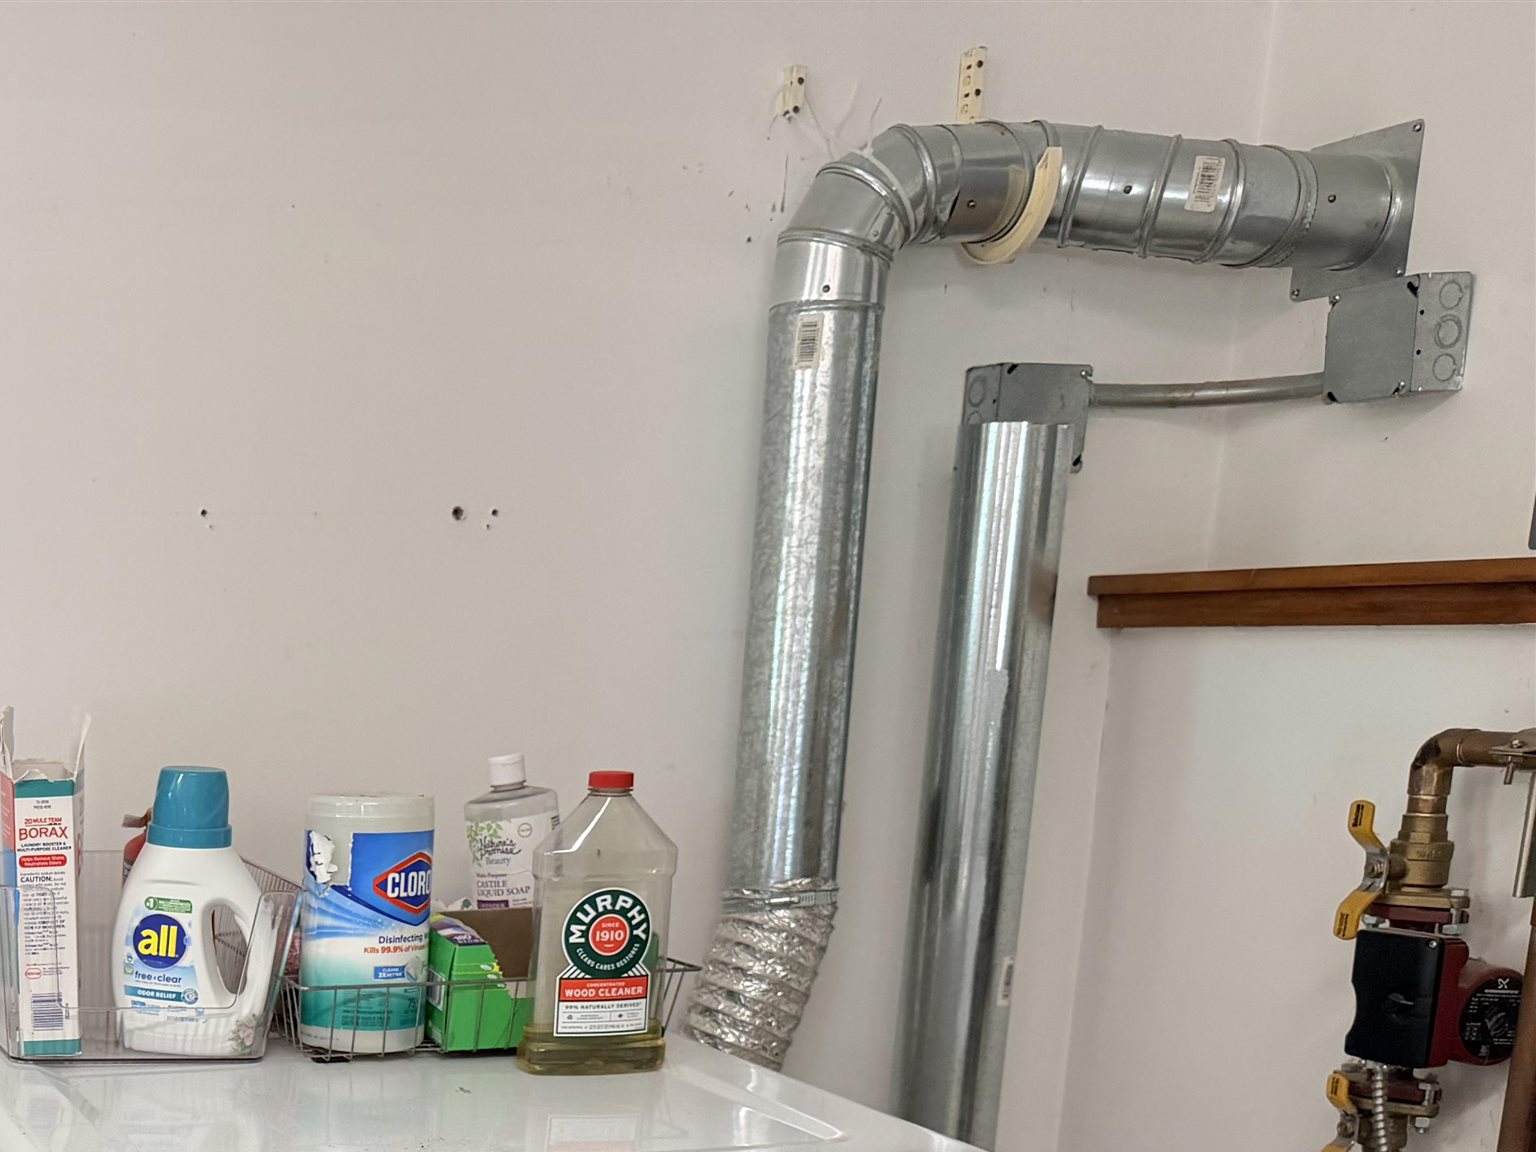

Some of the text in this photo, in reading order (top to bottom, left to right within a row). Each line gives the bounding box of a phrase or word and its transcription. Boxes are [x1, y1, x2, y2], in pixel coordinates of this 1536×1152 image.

[19, 827, 68, 841] BORAX
[486, 857, 510, 866] Beauty
[477, 886, 530, 897] LIQUID SOAP
[569, 895, 647, 943] MURPHY
[138, 925, 177, 957] all
[379, 935, 423, 944] Disinfecting
[596, 931, 624, 941] 1910
[577, 948, 596, 967] CLEANS
[135, 971, 182, 983] free clear
[565, 987, 643, 997] WOOD CLEANER
